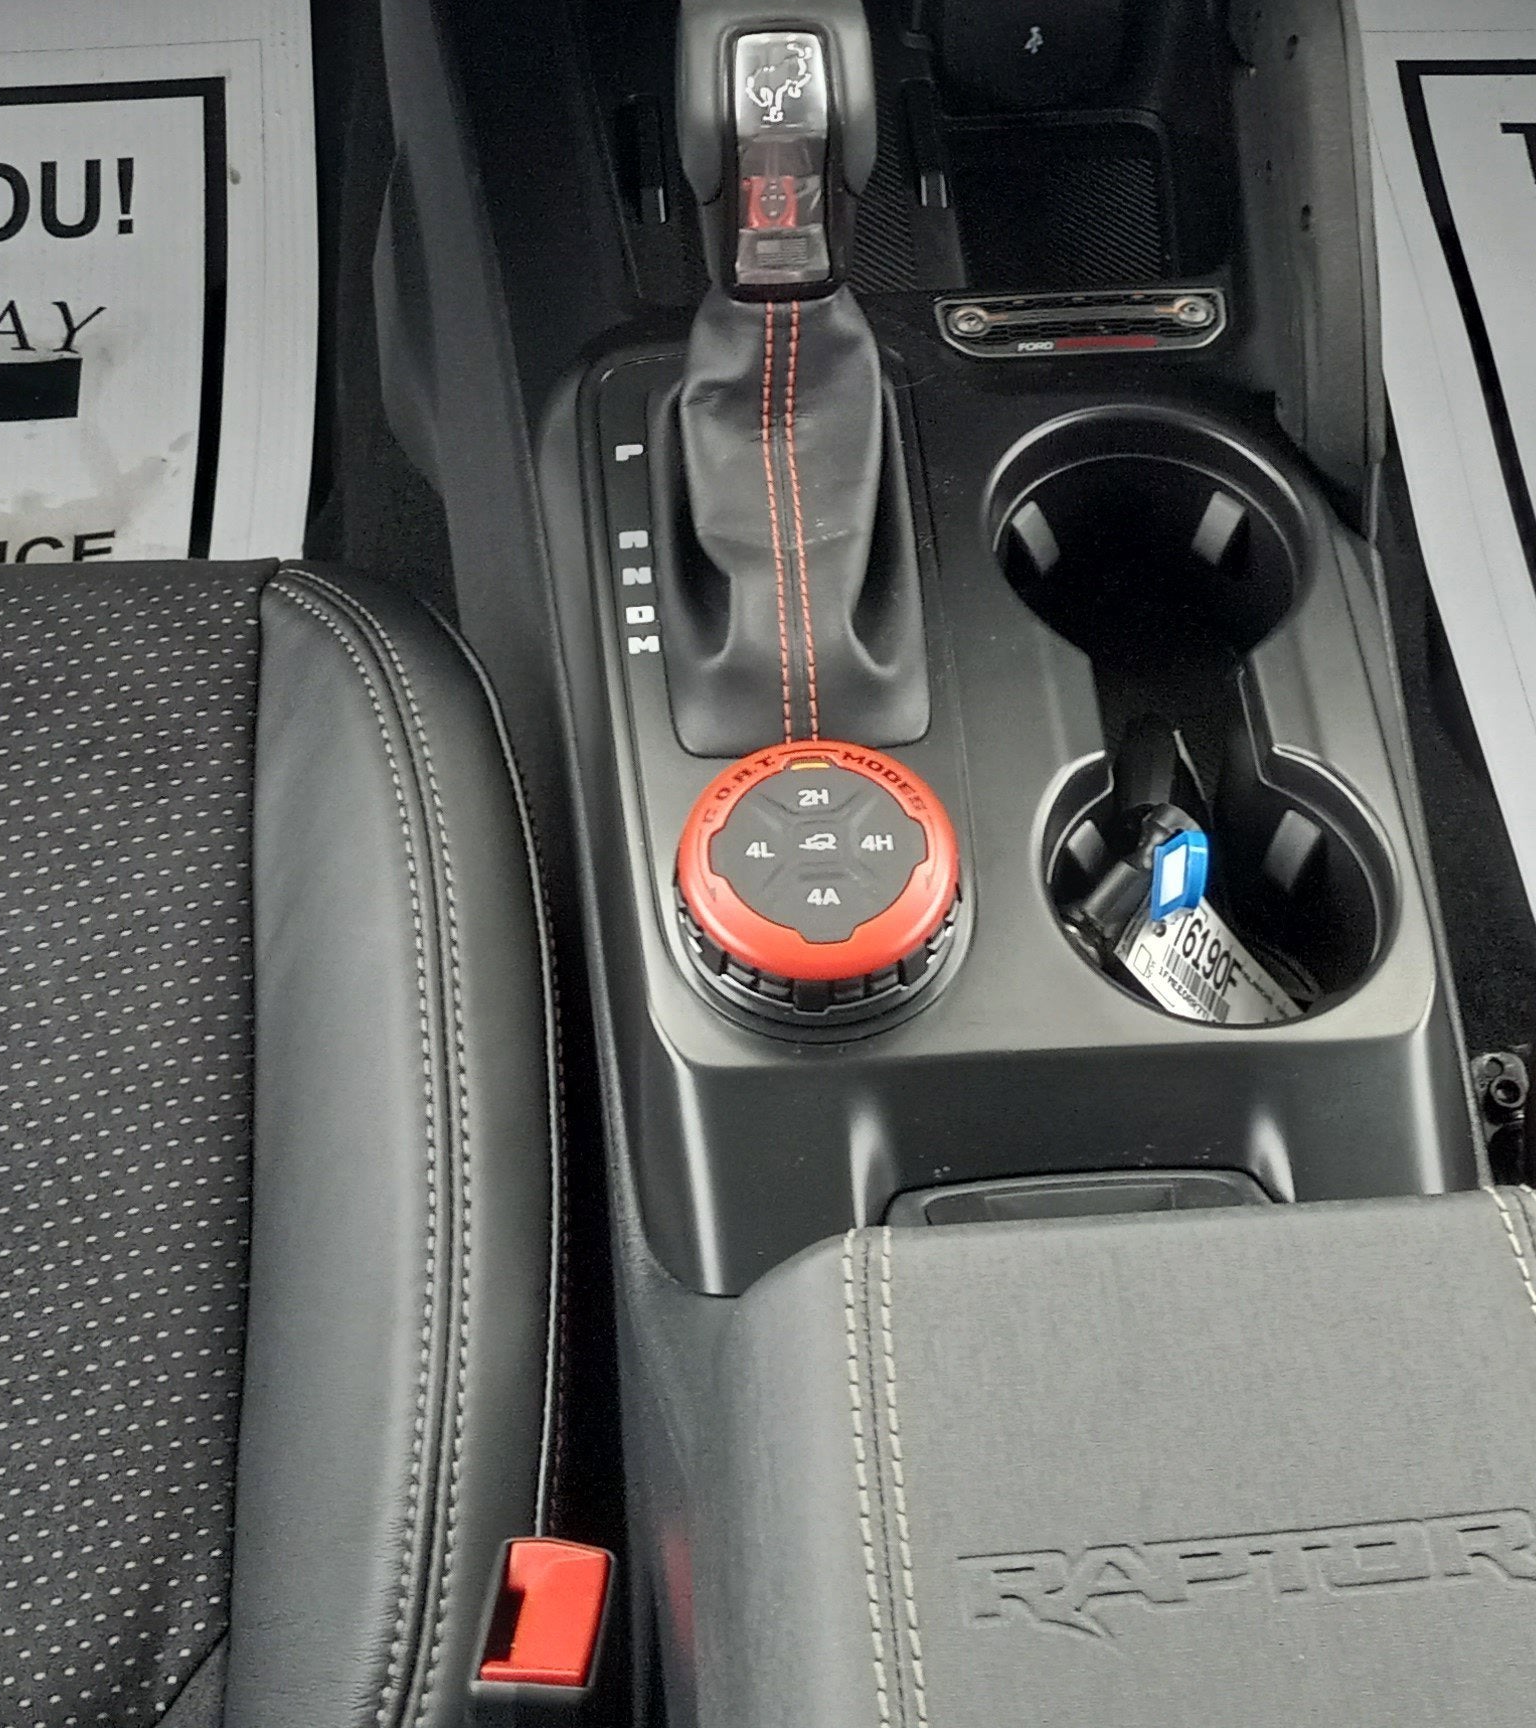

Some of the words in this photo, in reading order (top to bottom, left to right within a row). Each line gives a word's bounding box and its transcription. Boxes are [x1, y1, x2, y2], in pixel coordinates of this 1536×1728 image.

[1016, 339, 1055, 353] FORD
[615, 444, 644, 461] P
[622, 566, 652, 586] N
[625, 605, 655, 624] D
[627, 635, 660, 655] M
[841, 751, 928, 812] MODES
[797, 788, 830, 807] 2H
[745, 841, 776, 860] 4L
[860, 834, 894, 852] 4H
[806, 888, 842, 907] 4A
